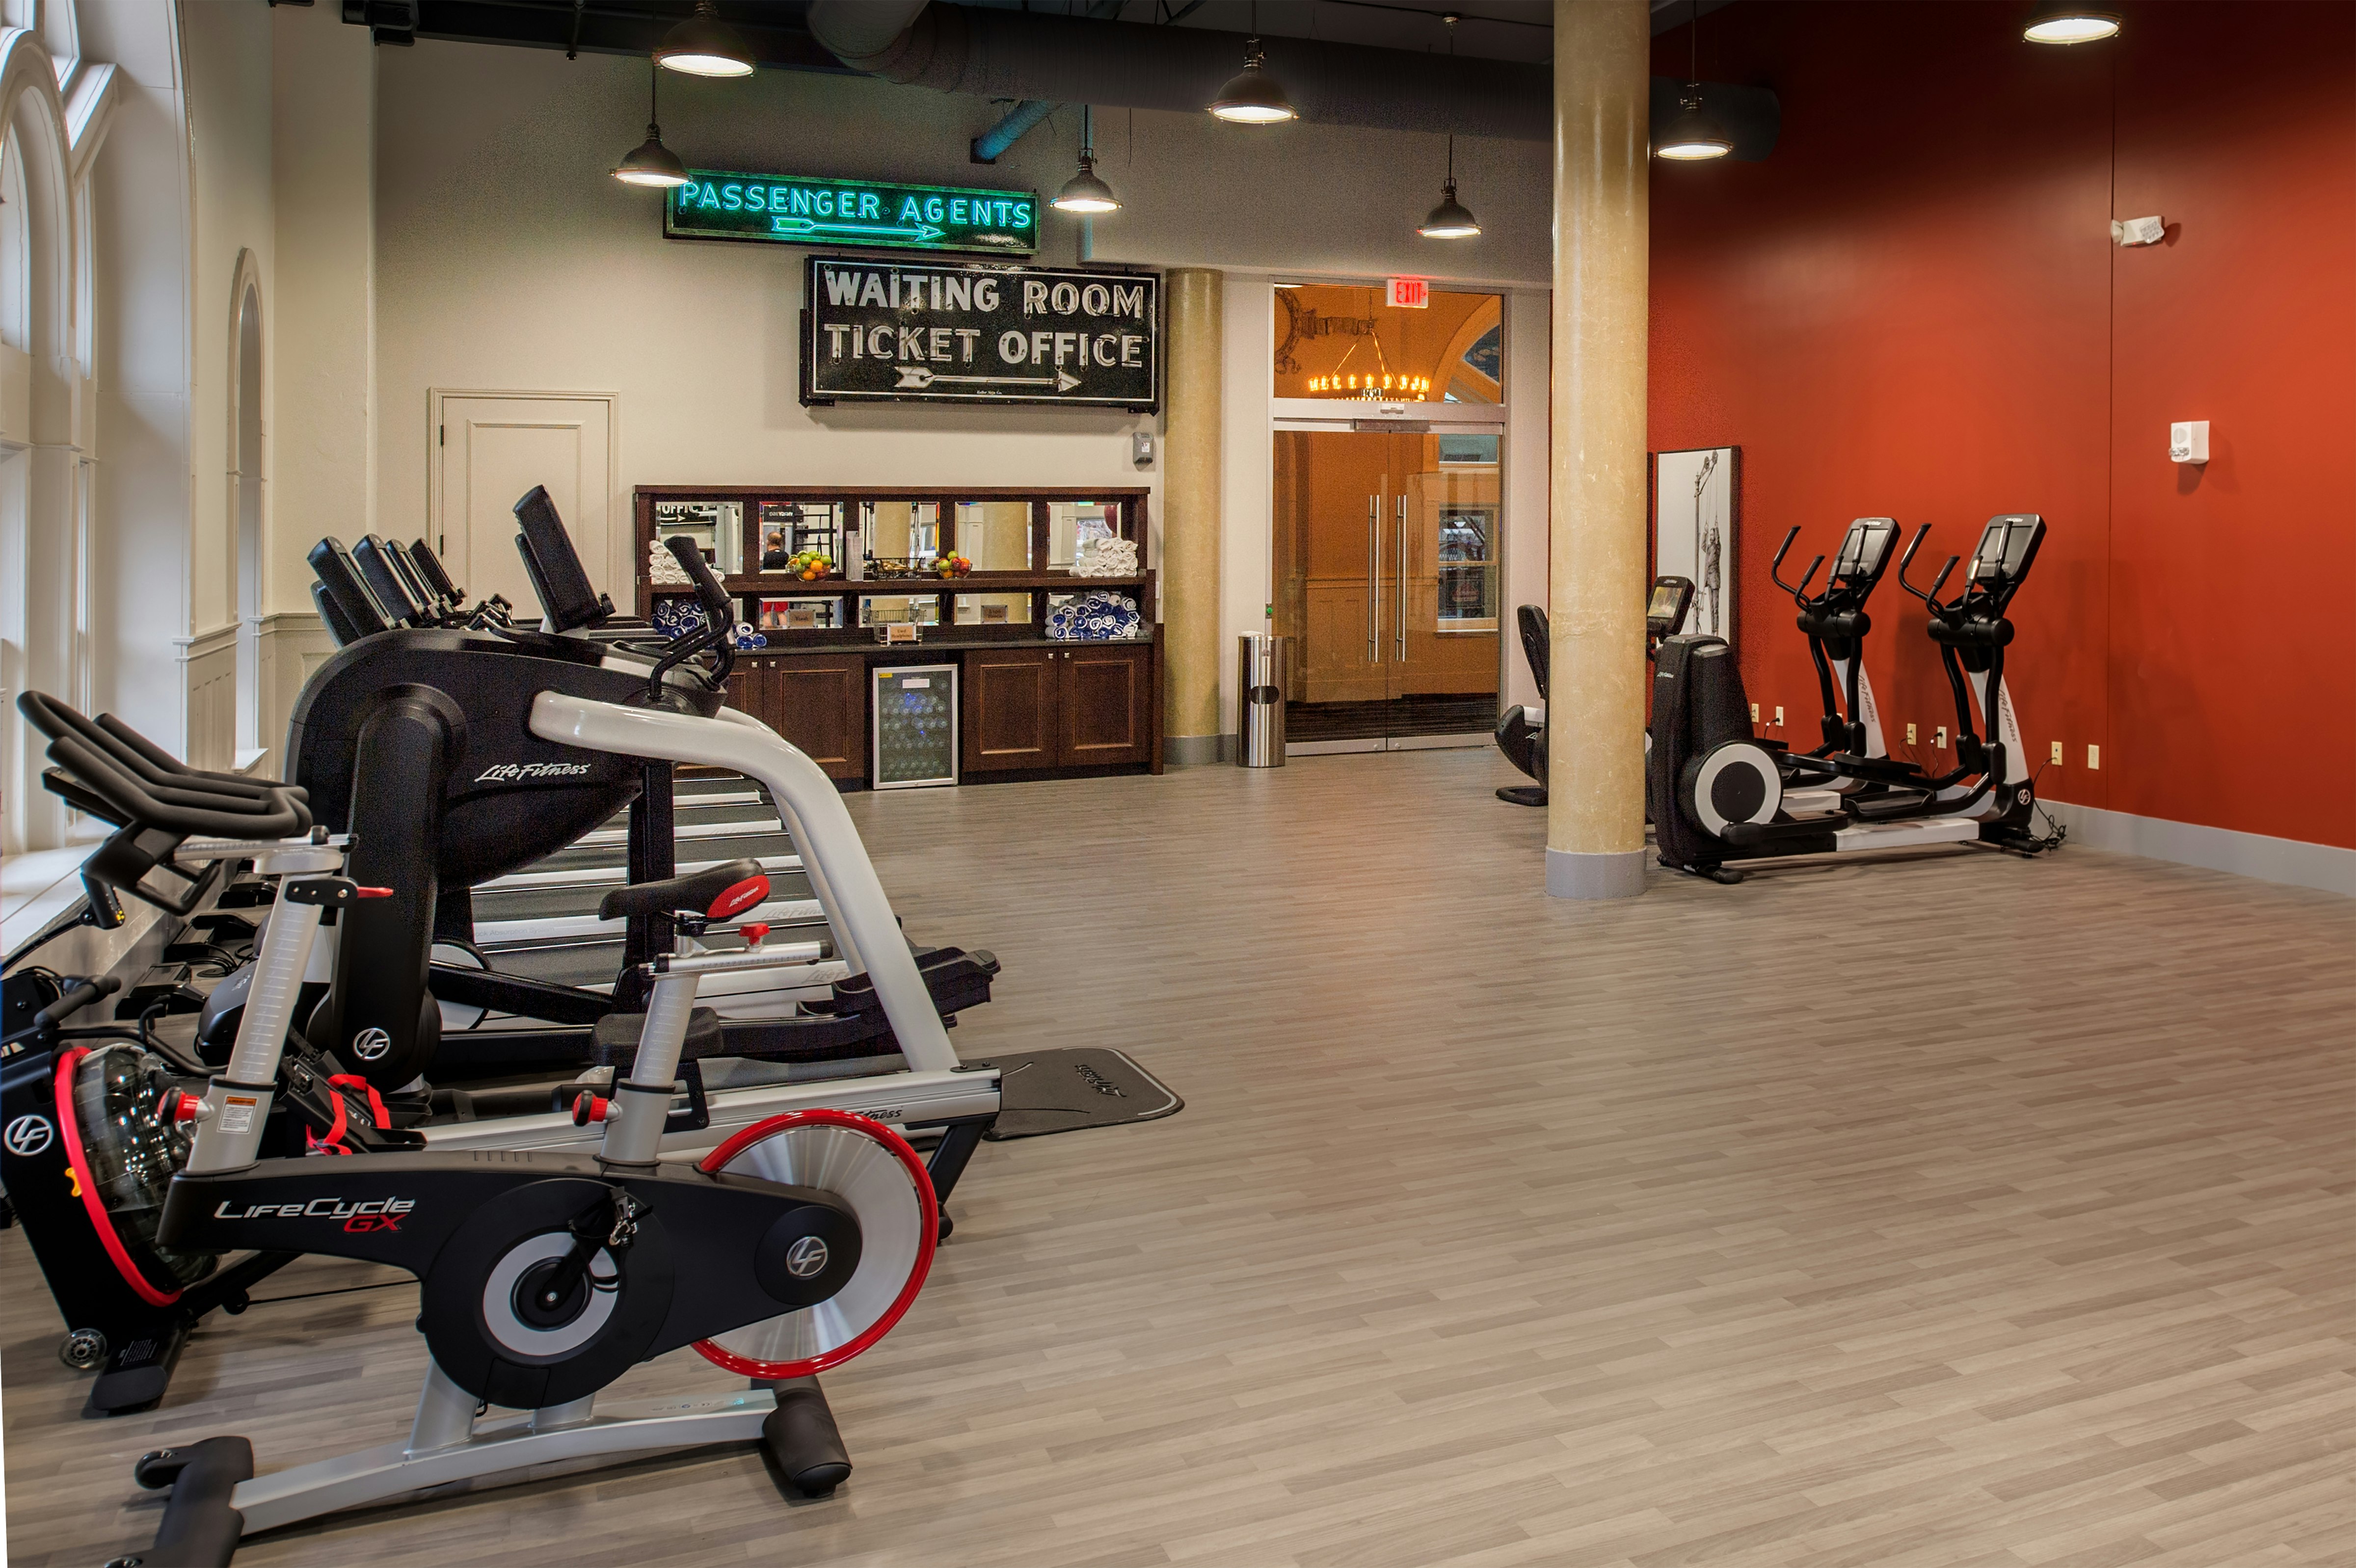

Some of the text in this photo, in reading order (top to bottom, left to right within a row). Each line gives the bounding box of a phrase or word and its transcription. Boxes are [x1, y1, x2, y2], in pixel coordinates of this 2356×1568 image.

[679, 182, 1031, 228] PASSENGER AGENTS
[824, 271, 1144, 318] WAITING ROOM
[1395, 282, 1422, 305] EXIT
[824, 323, 1143, 368] TICKET OFFICE
[344, 1214, 407, 1232] GX
